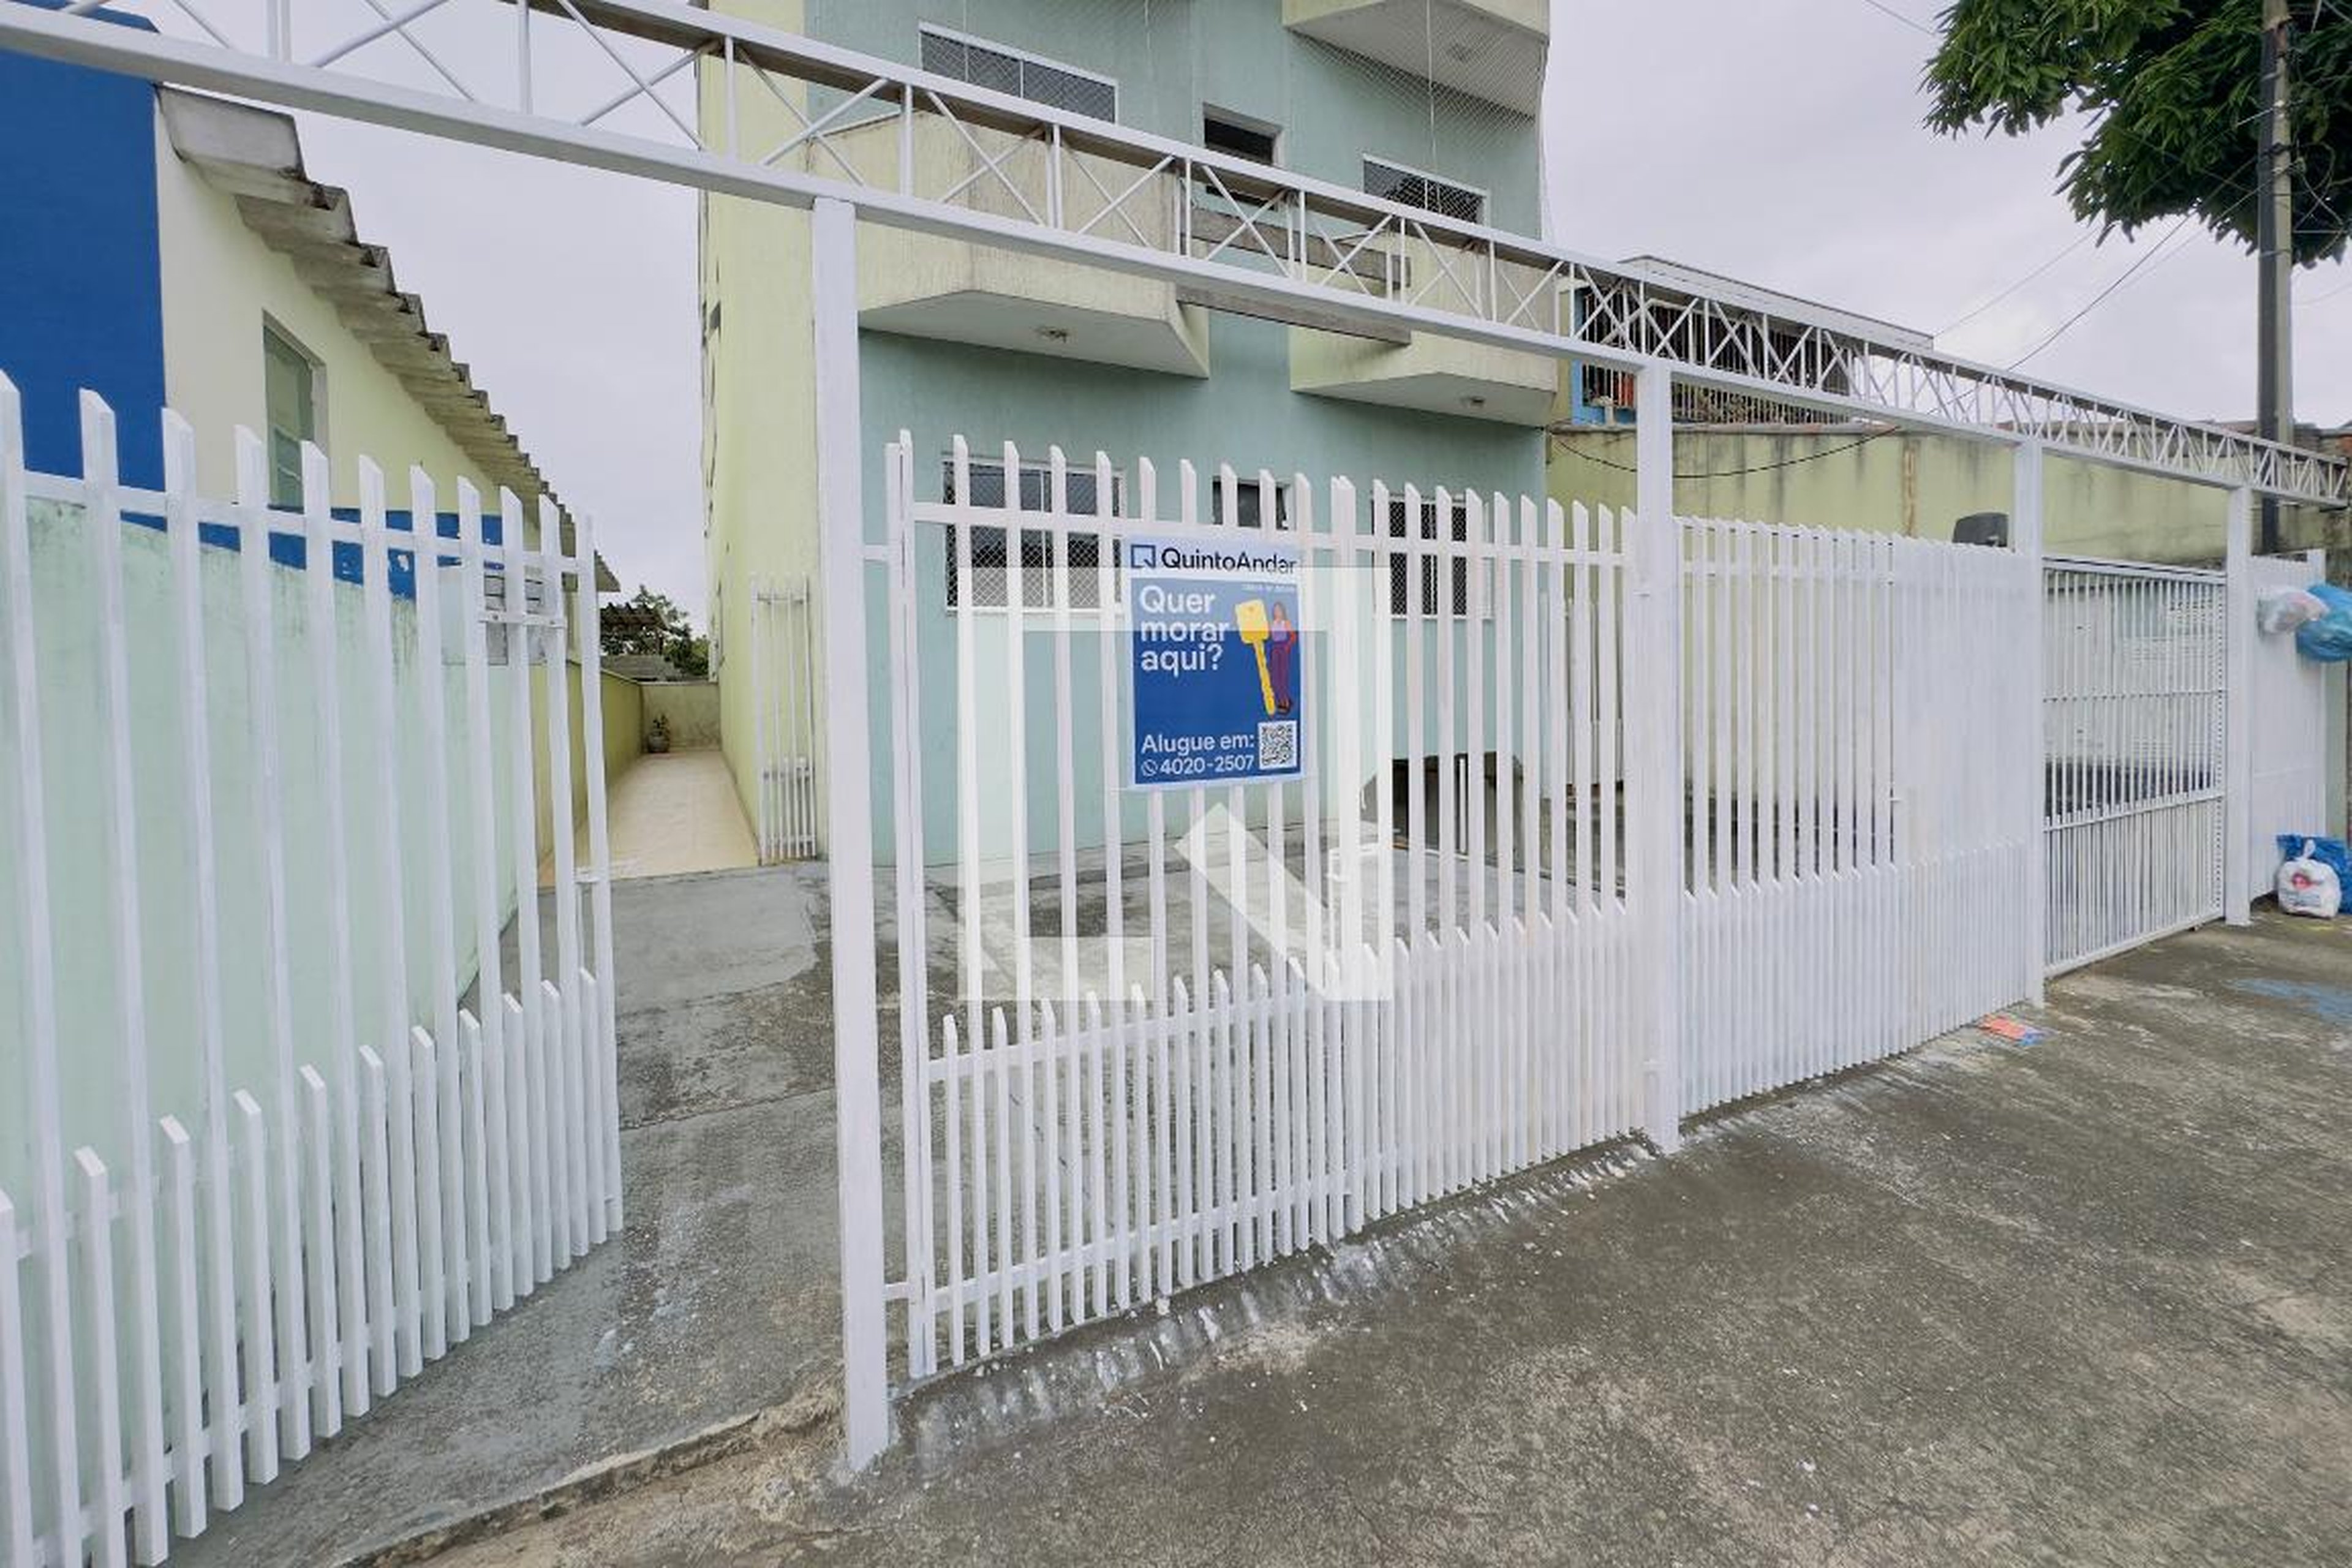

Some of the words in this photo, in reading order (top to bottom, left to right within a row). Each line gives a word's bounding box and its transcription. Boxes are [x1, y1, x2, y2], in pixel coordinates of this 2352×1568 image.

[1162, 548, 1297, 574] QuintoAndar
[1139, 585, 1216, 612] Quer
[1140, 620, 1229, 642] morar
[1140, 644, 1224, 677] aqui?
[1141, 734, 1215, 756] Alugue
[1220, 733, 1254, 749] em:
[1159, 755, 1254, 774] 4020-2507
